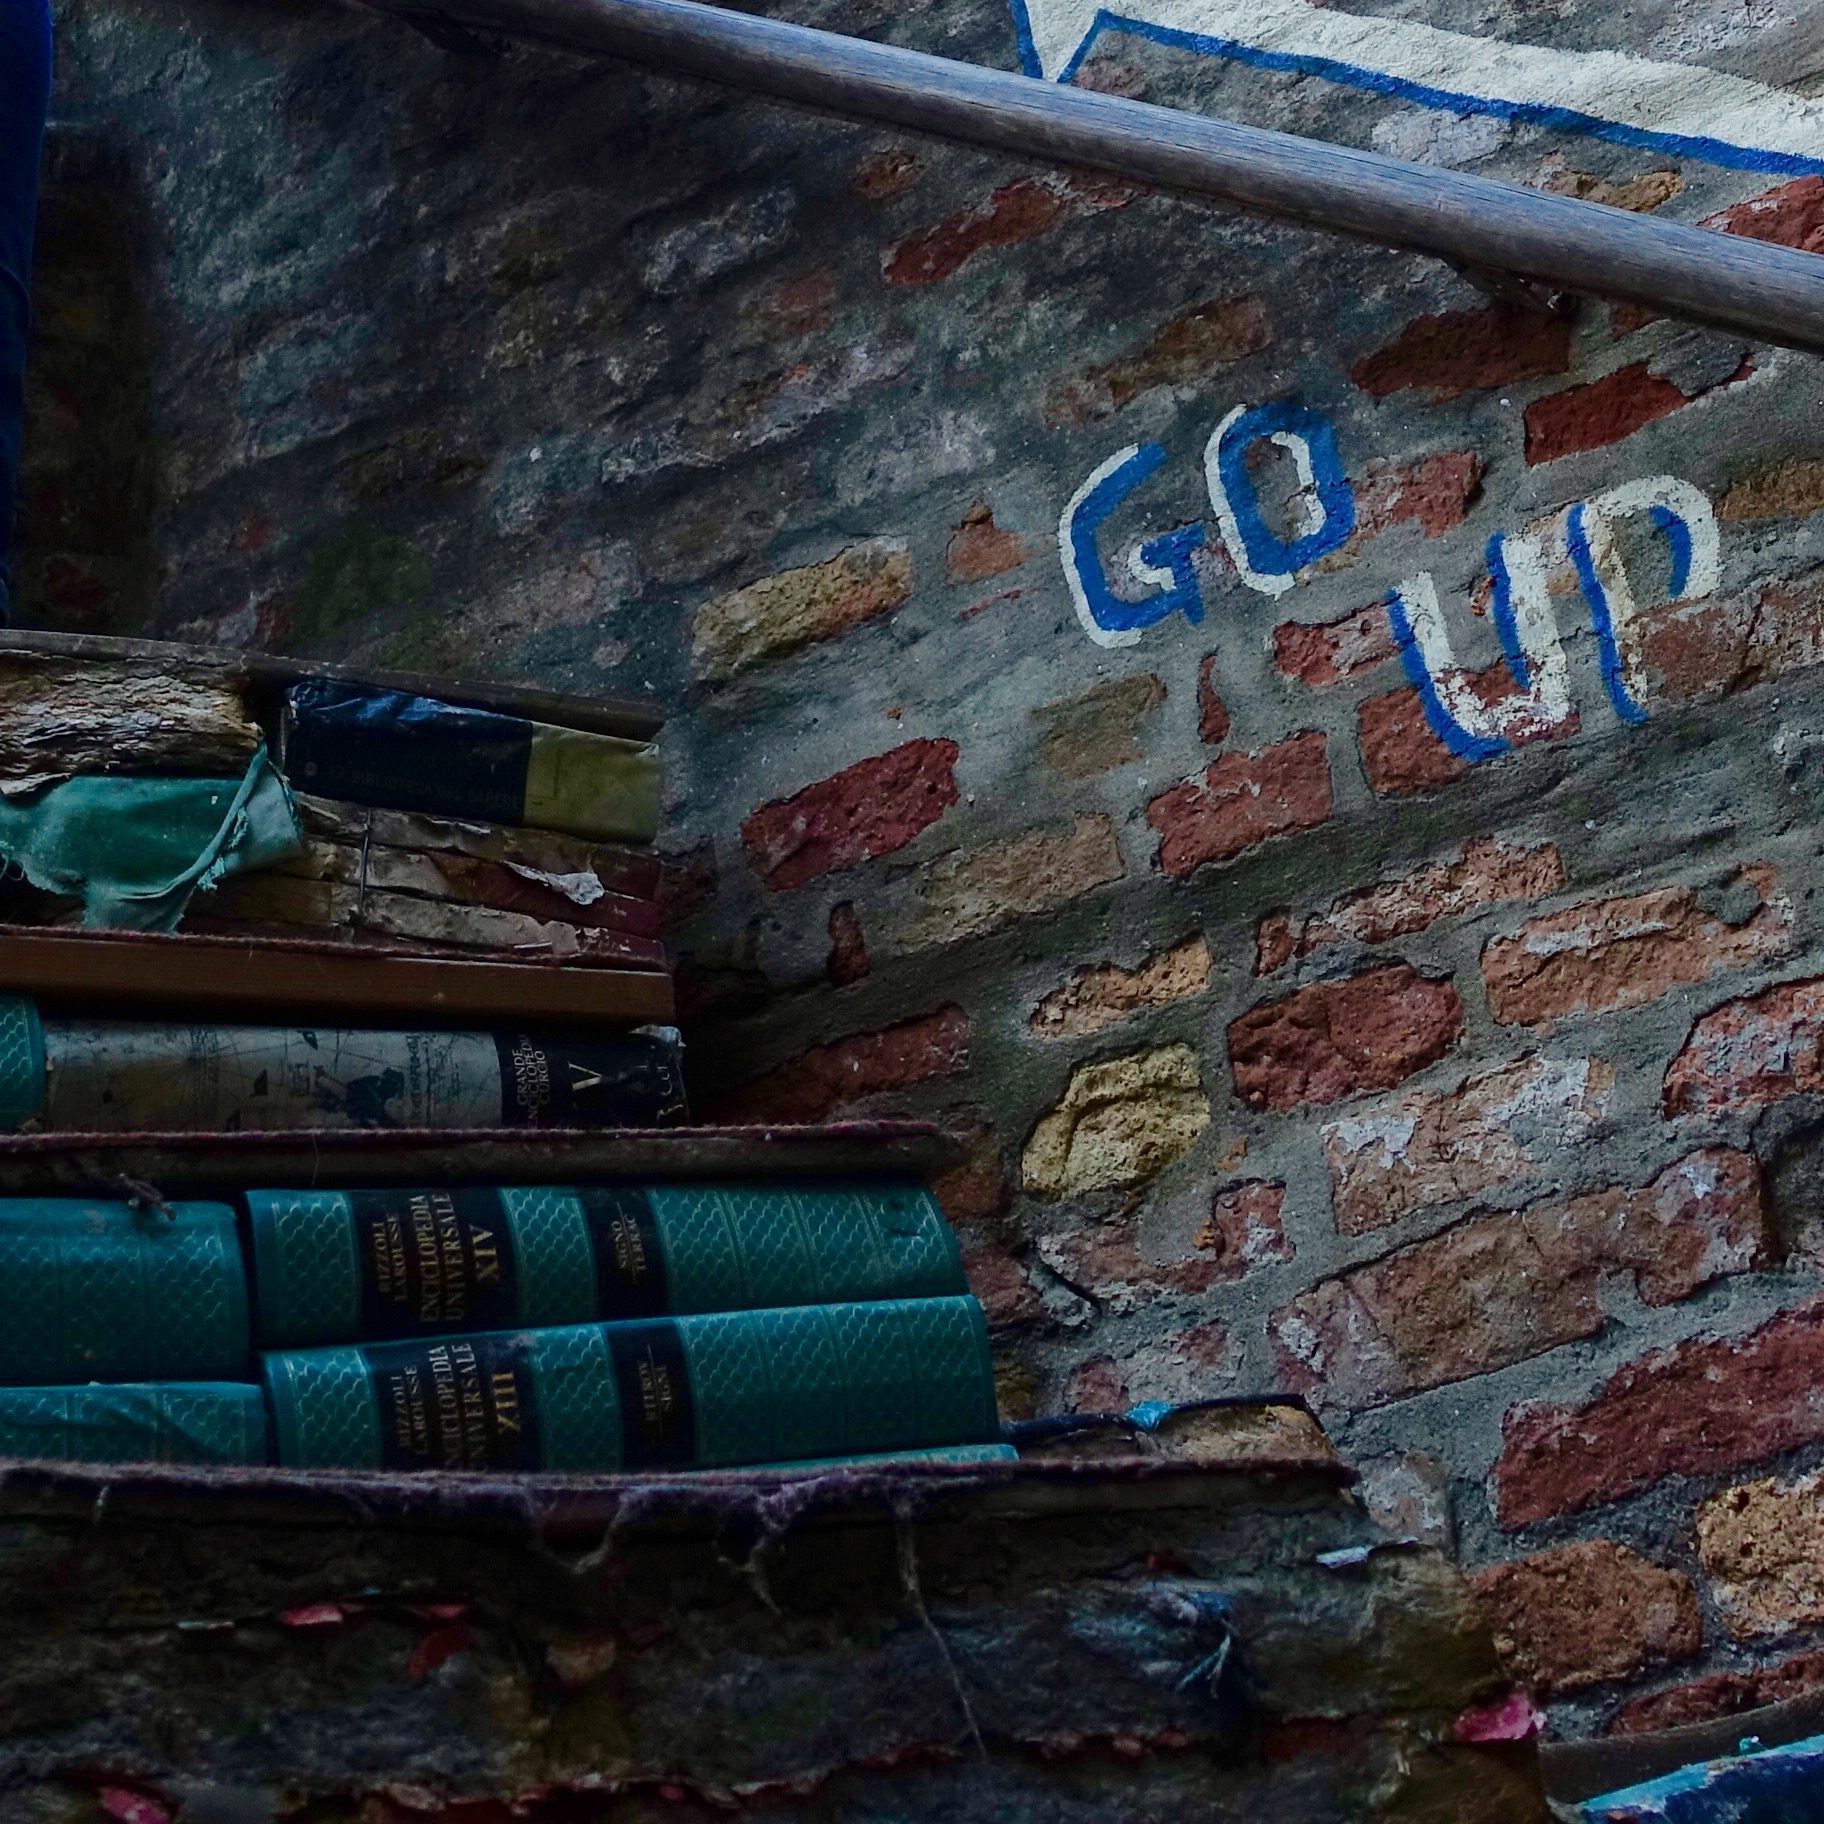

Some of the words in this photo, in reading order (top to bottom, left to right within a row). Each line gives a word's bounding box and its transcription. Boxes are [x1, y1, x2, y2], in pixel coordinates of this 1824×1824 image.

[1059, 400, 1357, 648] GO
[1386, 475, 1721, 762] UP
[512, 1048, 528, 1106] GRANDE
[534, 1050, 551, 1105] CURCIO
[372, 1221, 391, 1293] RIZZOLI
[386, 1213, 409, 1303] LAROUSSE
[409, 1194, 441, 1323] ENCICLOPEDIA
[431, 1192, 466, 1323] UNIVERSALE
[469, 1223, 501, 1285] XIV
[610, 1220, 628, 1270] SIGNO
[625, 1214, 647, 1274] TERRAC
[390, 1374, 413, 1448] RIZZOLI
[404, 1365, 429, 1456] LAROUSSE
[427, 1344, 462, 1468] NCICLOPEDIA
[491, 1372, 522, 1435] XIII
